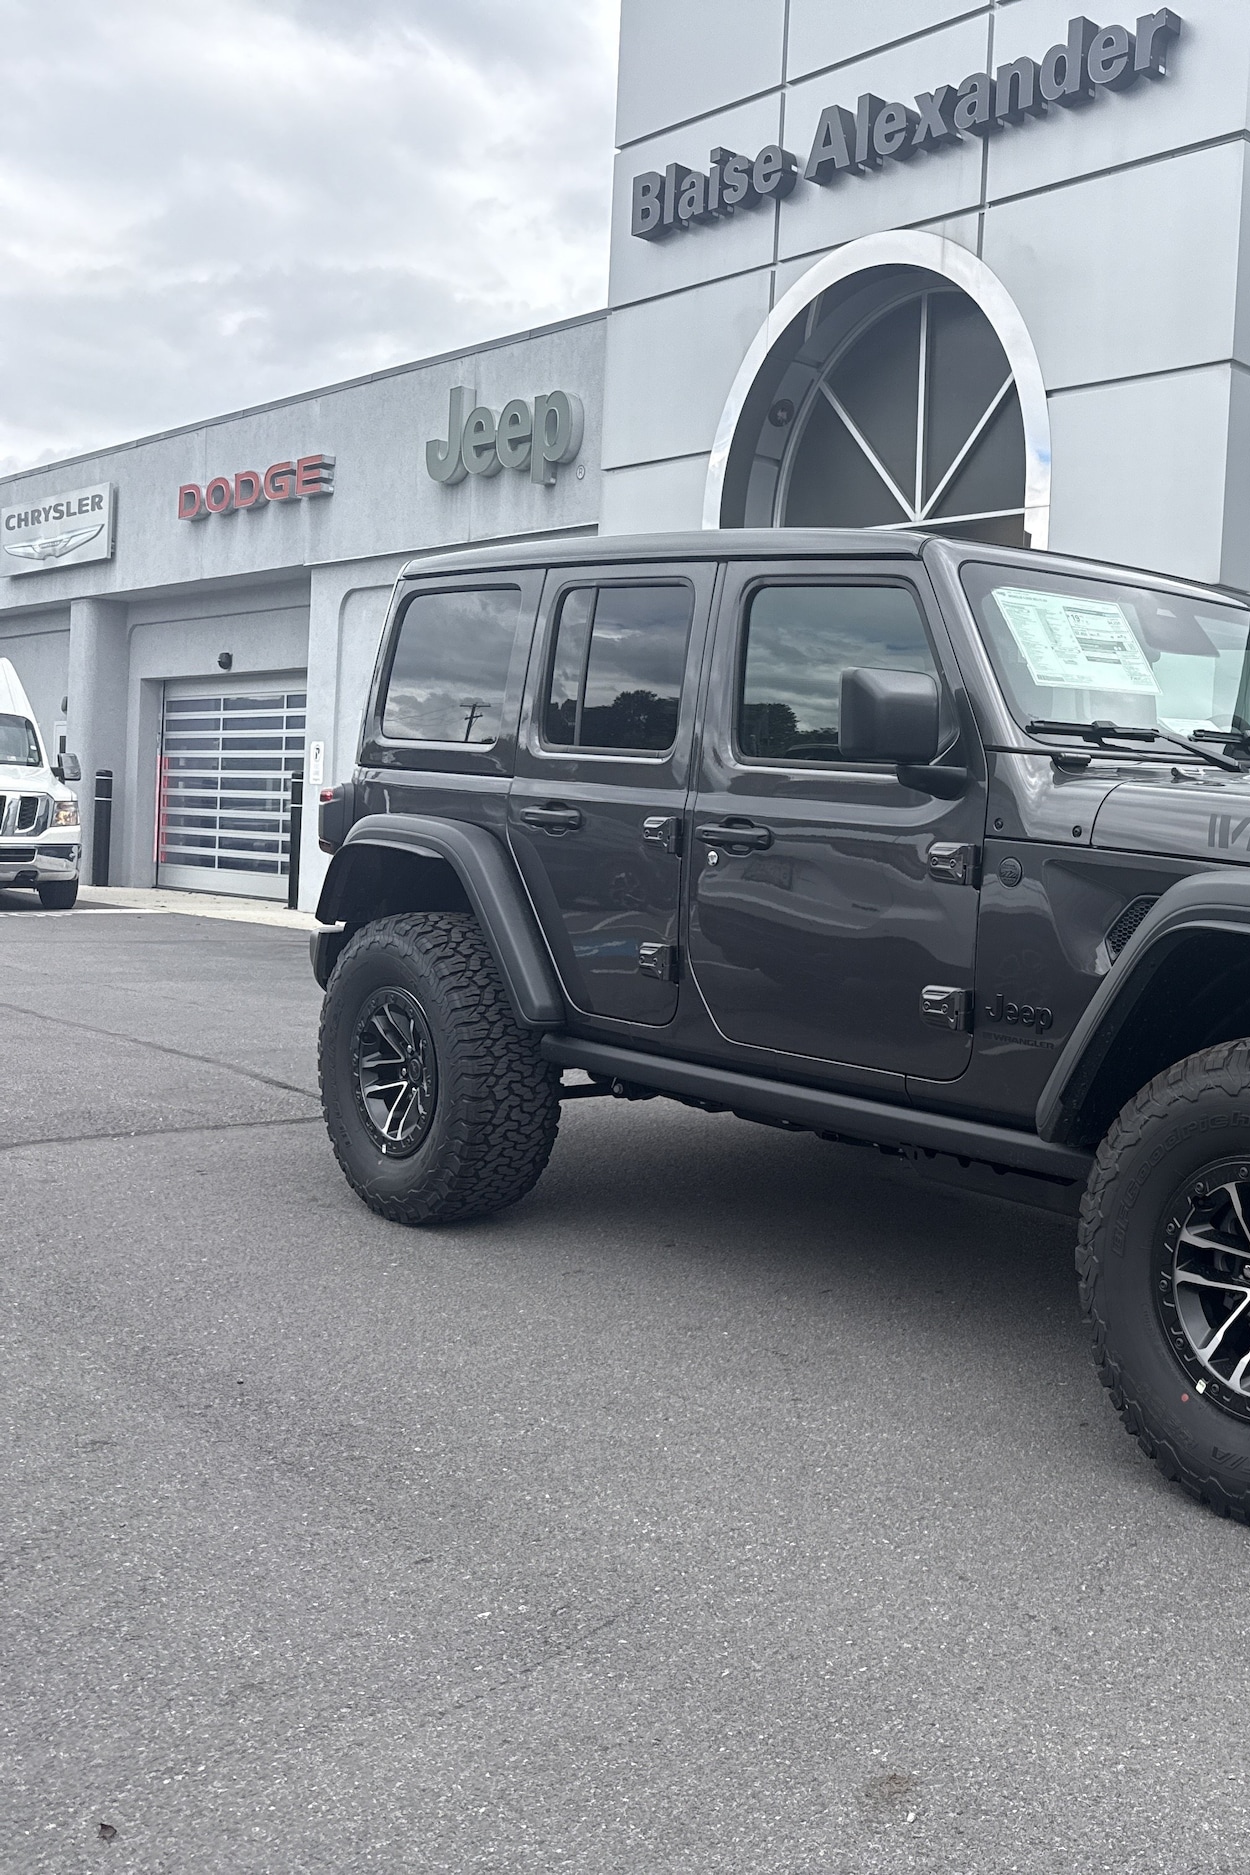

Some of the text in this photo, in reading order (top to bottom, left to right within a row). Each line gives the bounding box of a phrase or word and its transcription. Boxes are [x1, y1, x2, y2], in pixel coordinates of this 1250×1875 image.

[631, 7, 1181, 241] Blaise Alexander
[425, 385, 584, 487] Jeep
[5, 494, 104, 531] CHRYSLER
[178, 454, 335, 521] DODGE
[984, 993, 1053, 1035] Jeep
[993, 1032, 1055, 1050] WRANGLER
